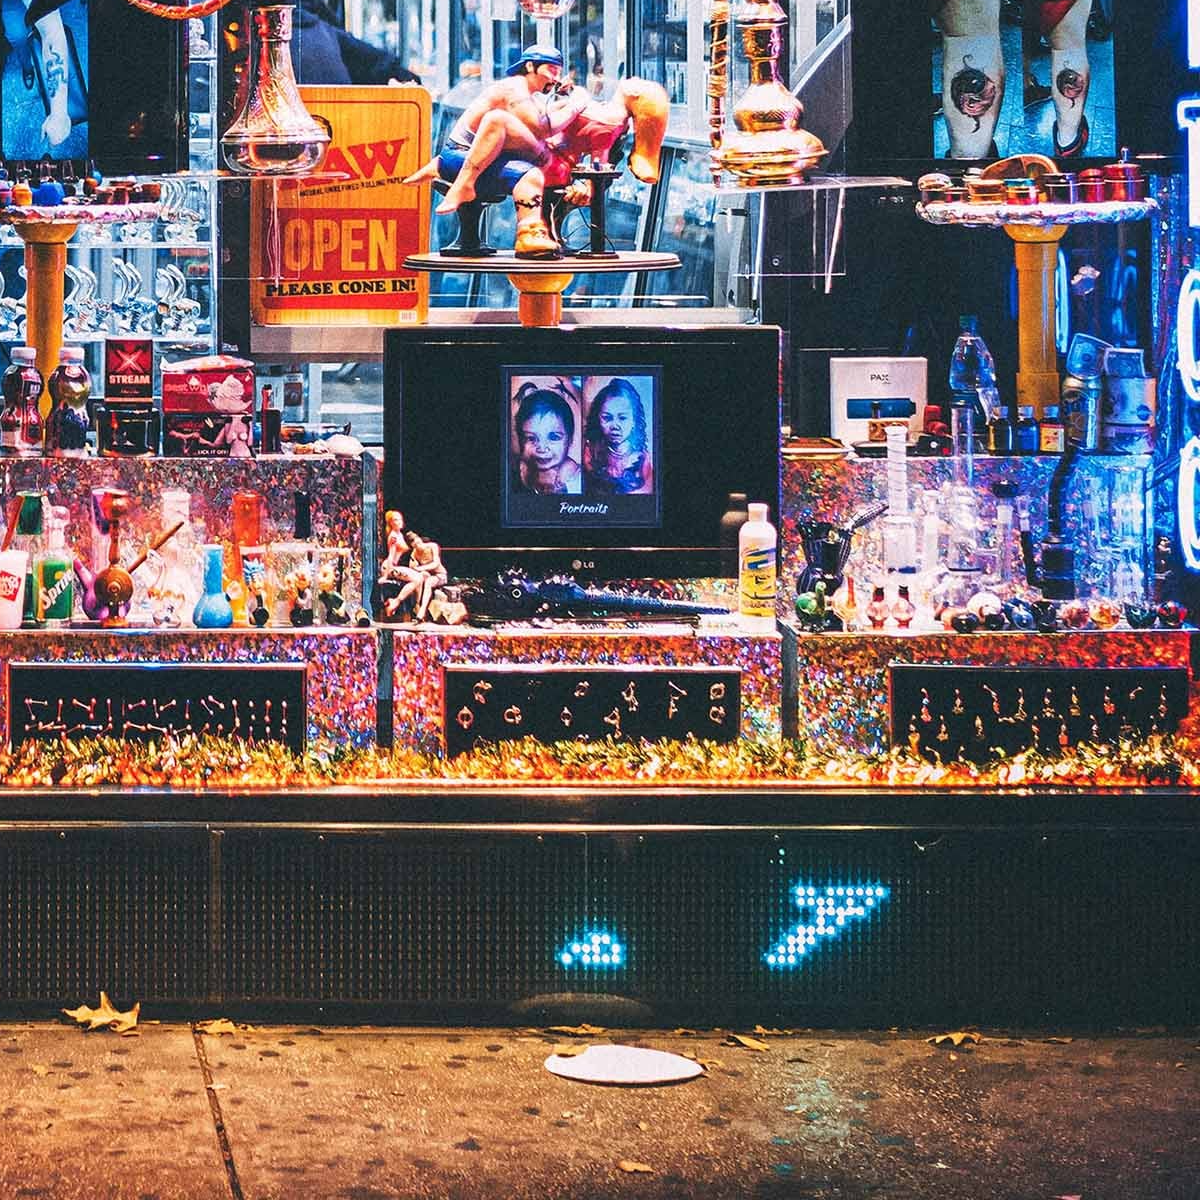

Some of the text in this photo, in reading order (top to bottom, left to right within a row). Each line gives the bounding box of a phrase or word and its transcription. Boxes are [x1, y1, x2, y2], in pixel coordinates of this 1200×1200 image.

[284, 219, 398, 272] OPEN
[265, 279, 416, 297] PLEASE CONE IN!
[109, 375, 151, 384] STREAM
[560, 502, 609, 514] Portraits
[583, 561, 595, 569] LG
